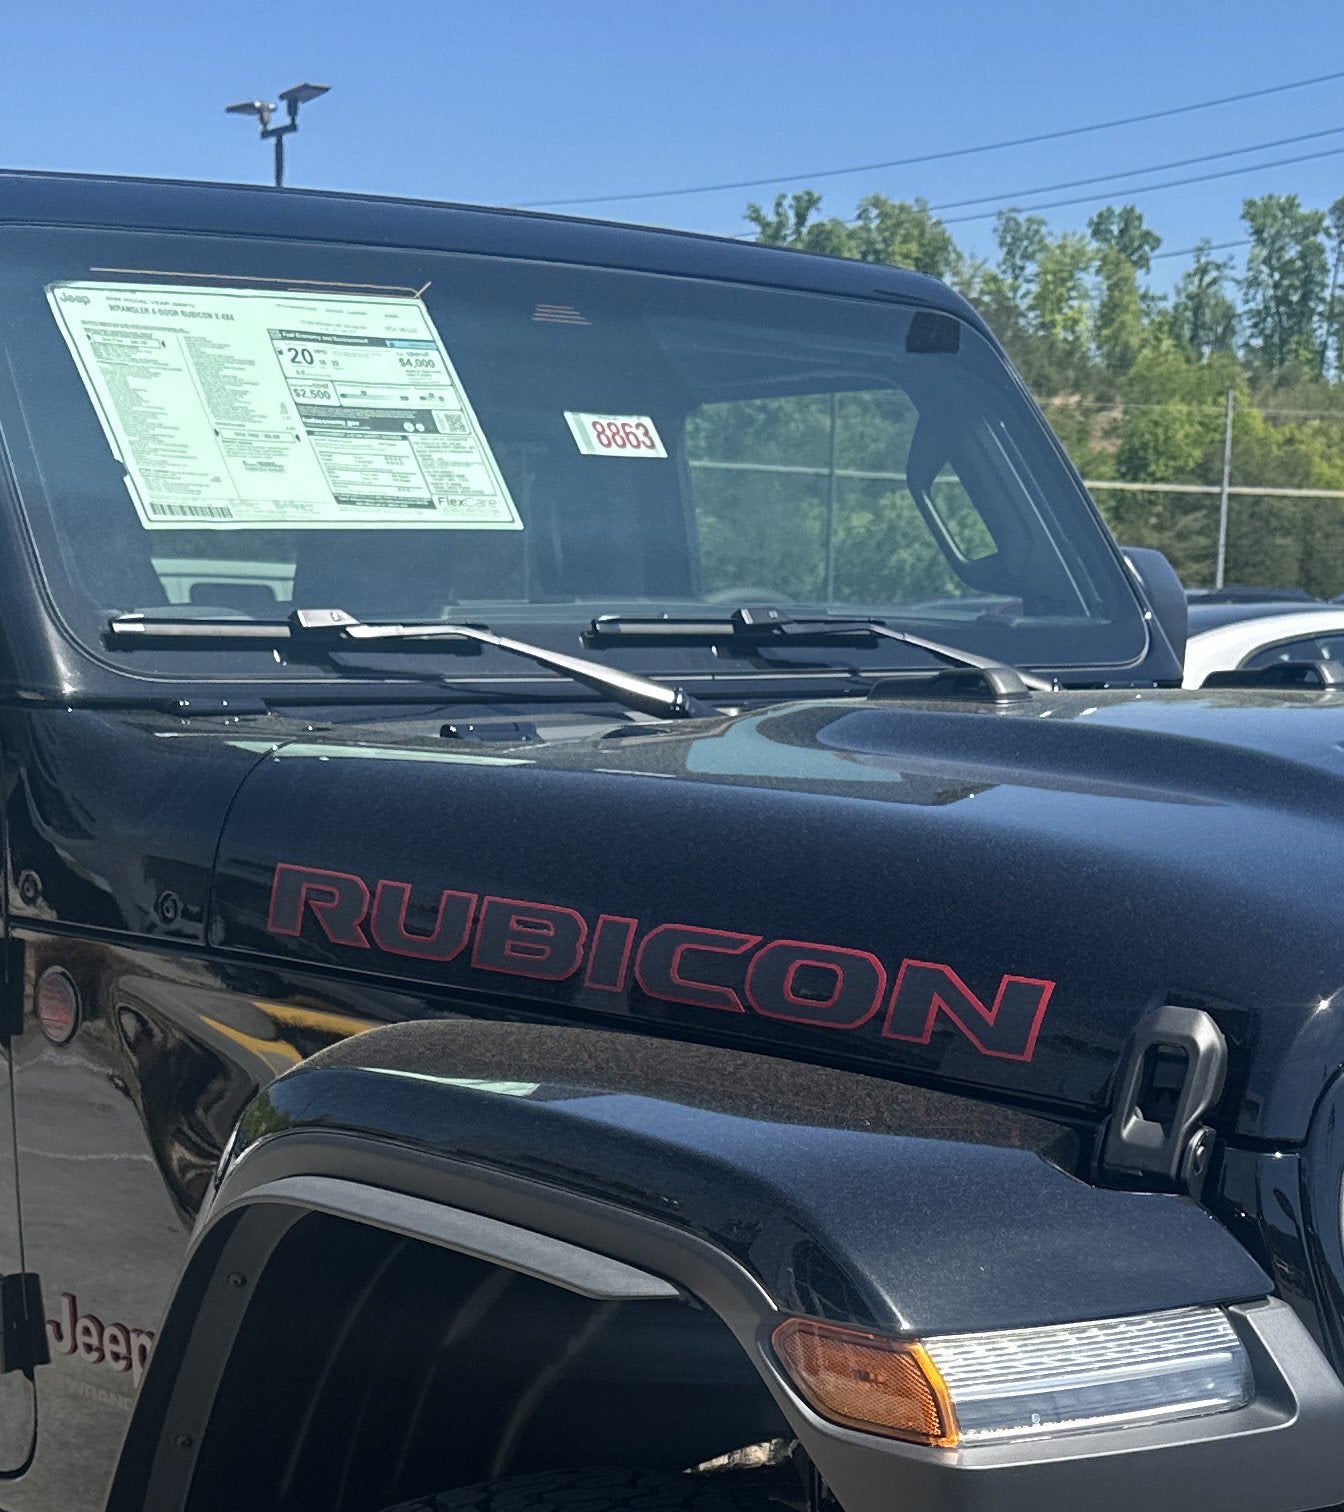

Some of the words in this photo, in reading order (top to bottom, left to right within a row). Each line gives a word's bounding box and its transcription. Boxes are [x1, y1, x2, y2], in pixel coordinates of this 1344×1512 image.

[287, 347, 315, 365] 20
[399, 357, 435, 369] $4,000
[591, 420, 656, 449] 8863
[267, 861, 1056, 1062] RUBICON
